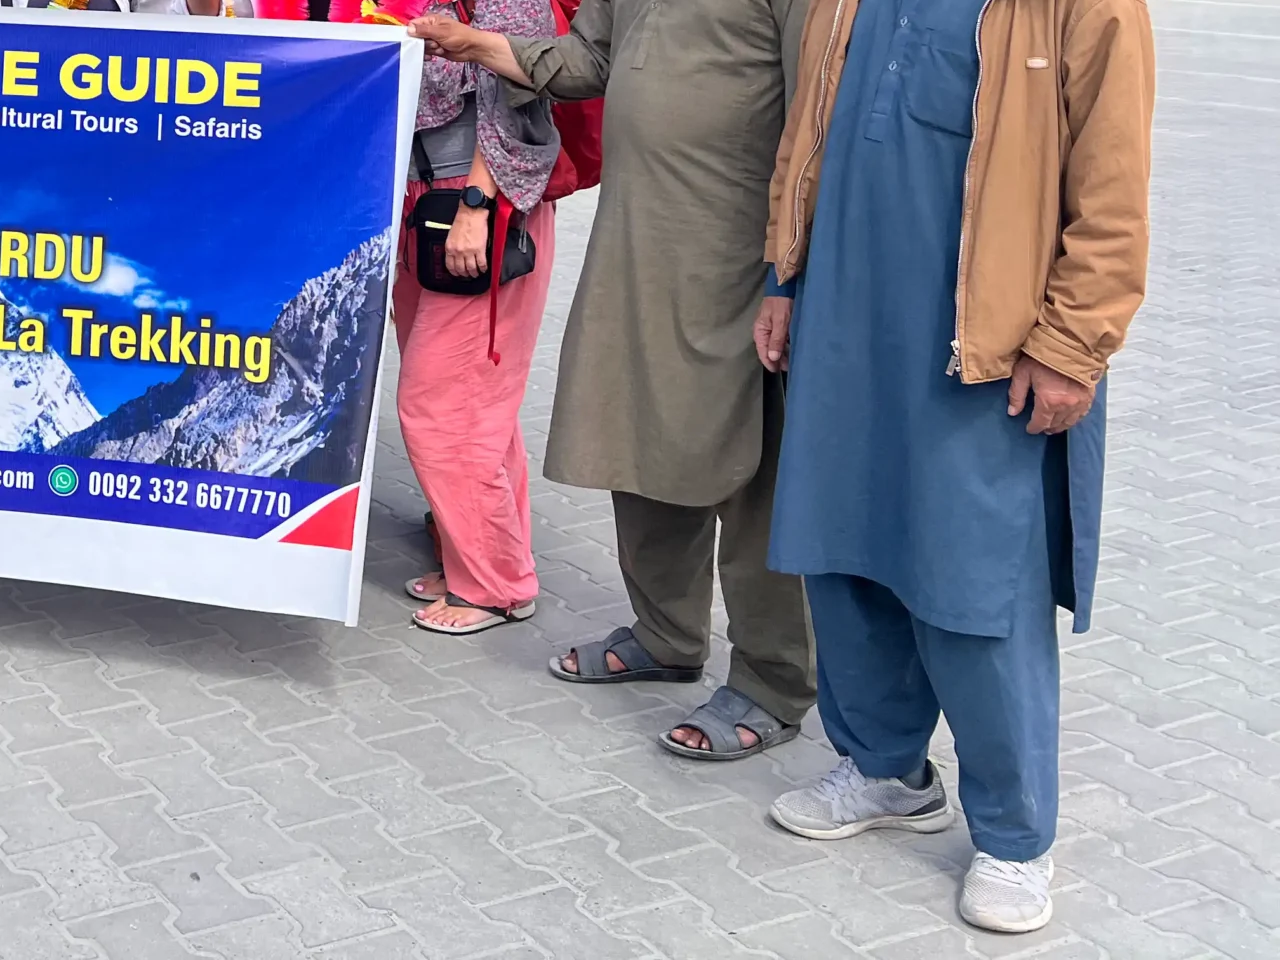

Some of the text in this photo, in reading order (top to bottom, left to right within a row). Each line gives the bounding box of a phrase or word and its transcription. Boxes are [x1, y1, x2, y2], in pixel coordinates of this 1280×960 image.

[59, 52, 262, 108] GUIDE
[70, 109, 139, 134] Tours
[174, 115, 263, 140] Safaris
[62, 307, 272, 383] Trekking
[88, 470, 292, 519] 0092 332 6677770
